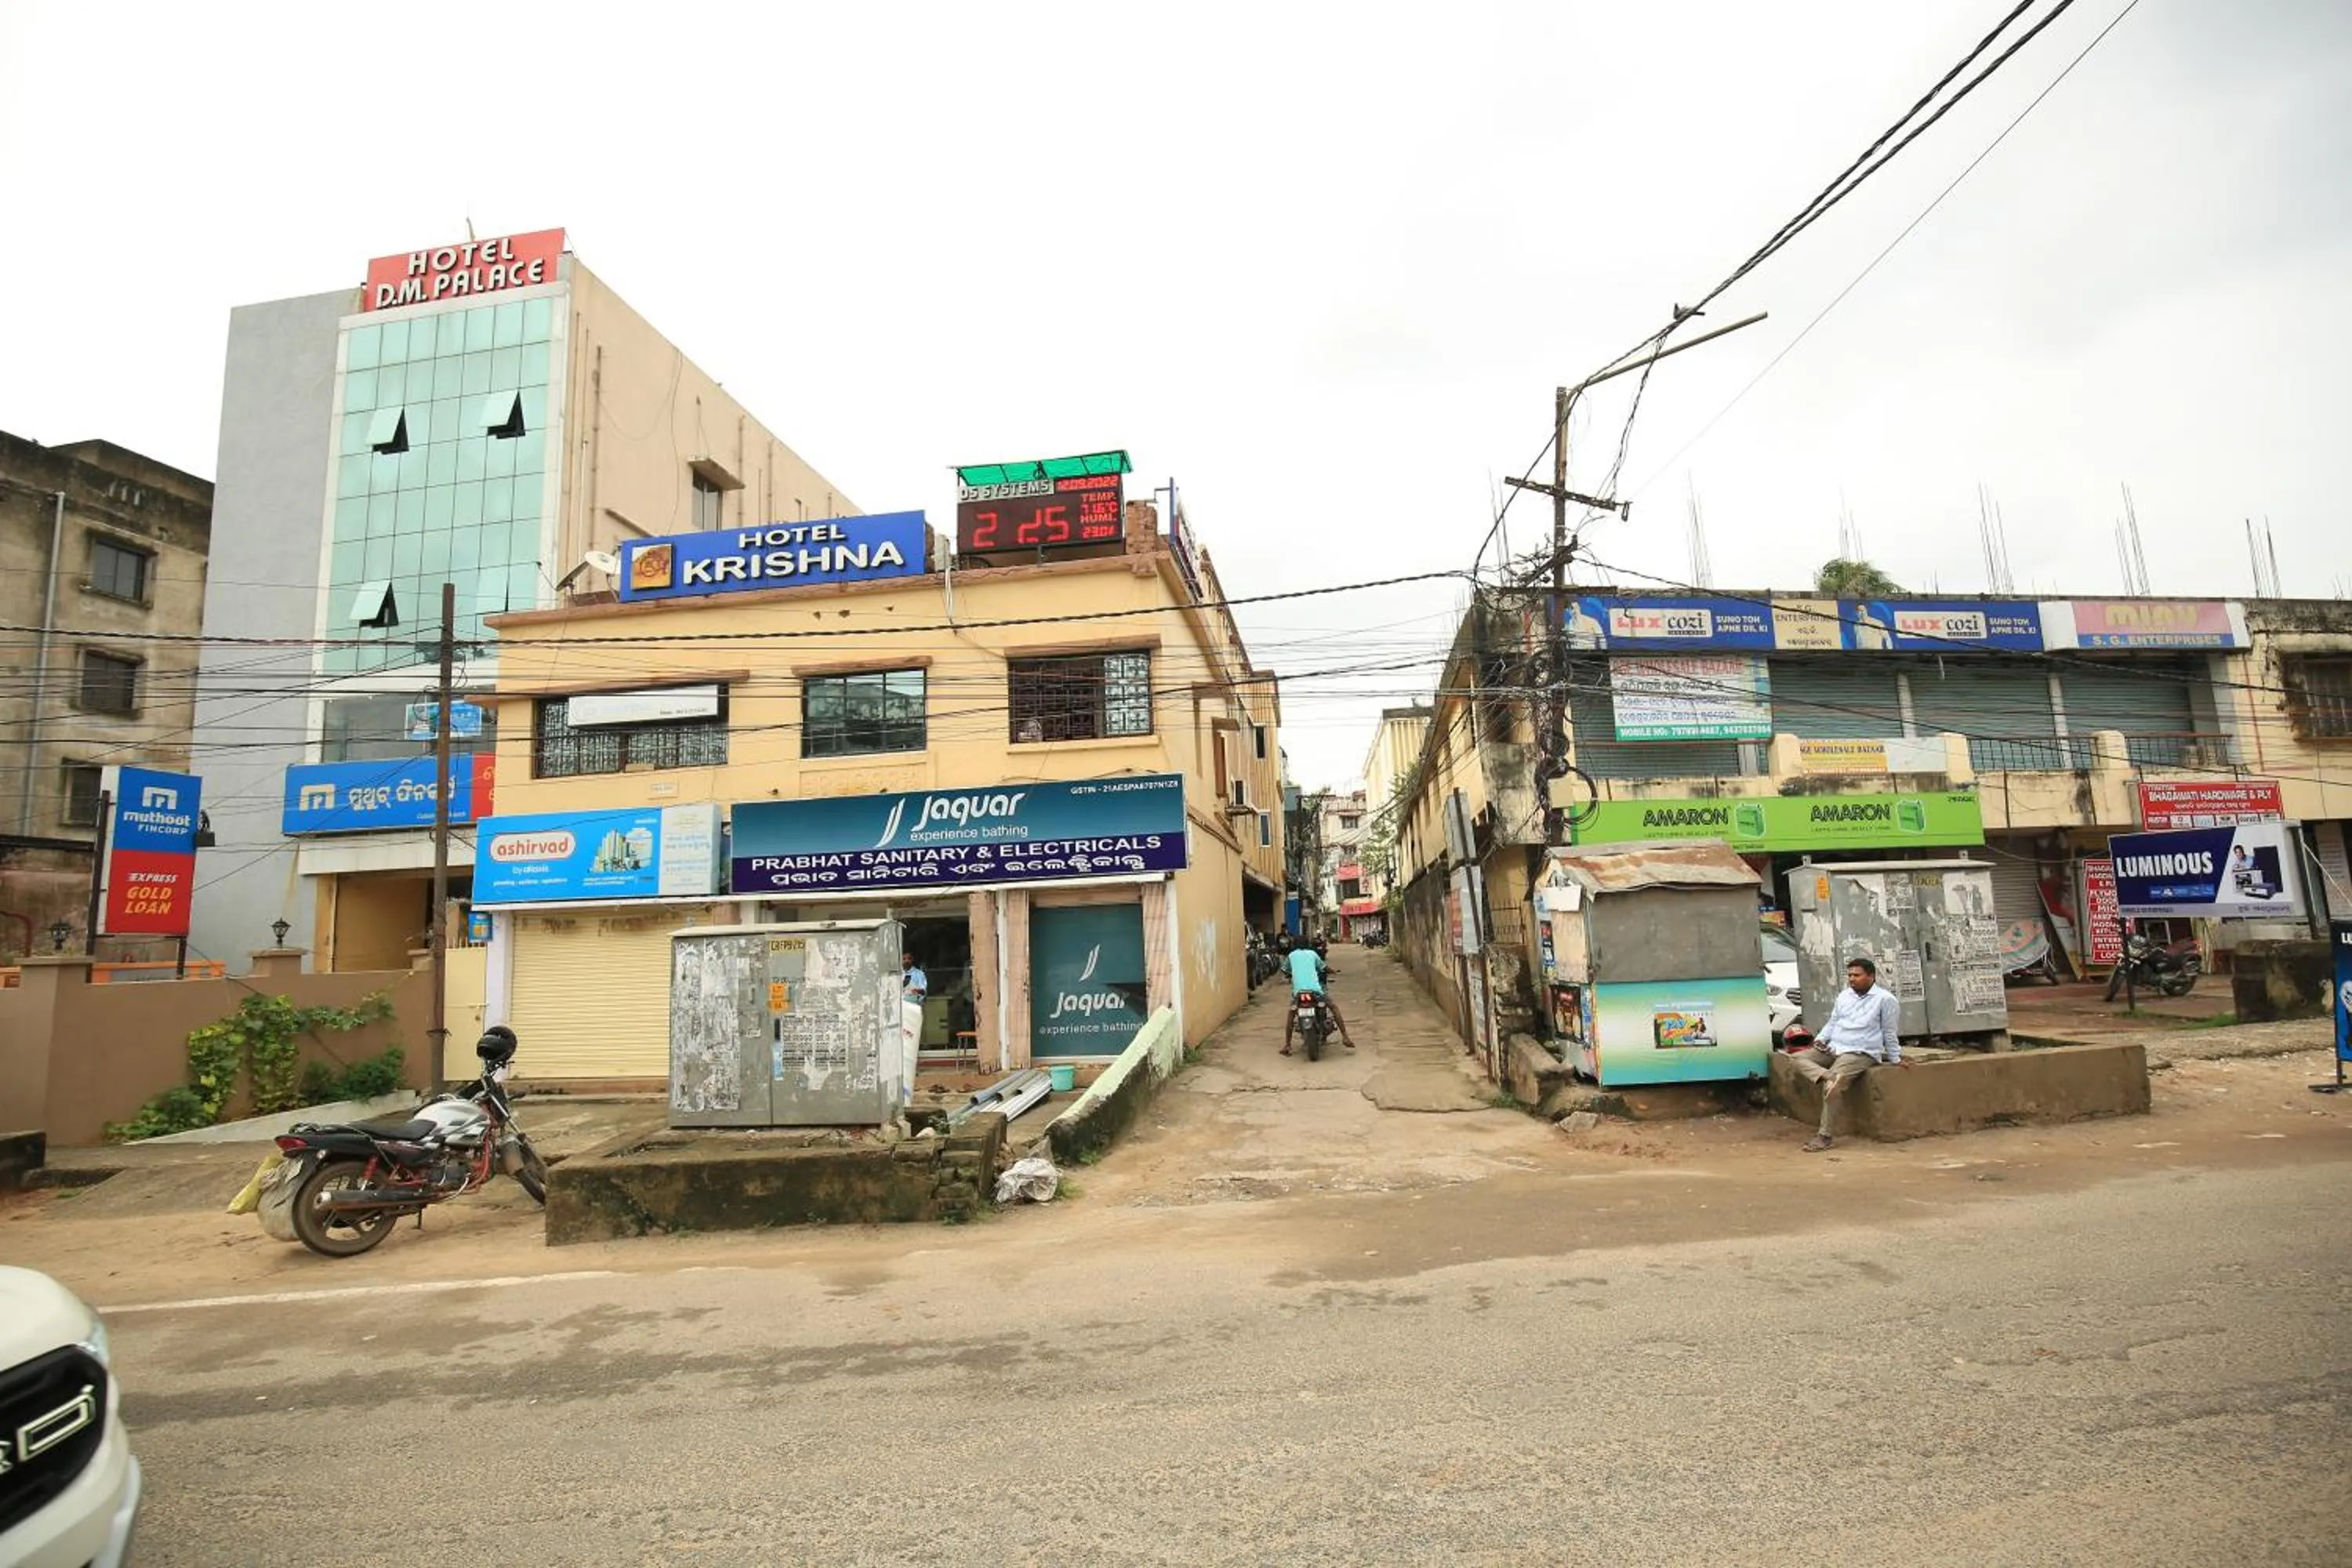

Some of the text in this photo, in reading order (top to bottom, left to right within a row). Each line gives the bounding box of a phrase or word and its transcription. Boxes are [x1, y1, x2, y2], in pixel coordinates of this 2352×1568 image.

[408, 238, 514, 275] HOTEL
[376, 258, 544, 308] D.M. PALACE
[983, 480, 1050, 497] SYSTEMS
[739, 524, 846, 549] HOTEL
[683, 541, 905, 584] KRISHNA
[1668, 612, 1704, 630] cozi
[1901, 615, 1978, 631] LUX cozi
[2129, 635, 2222, 645] ENTERPRISES
[2200, 789, 2248, 801] HARDWARE
[123, 811, 191, 827] muthoot
[911, 793, 1025, 832] Jaquar
[1643, 808, 1729, 827] AMARON
[1811, 804, 1892, 822] AMARON
[138, 823, 188, 836] FINCORP
[910, 825, 1028, 843] experience bathing
[496, 836, 569, 856] ashirvad
[752, 836, 1162, 871] PRABHAT SANITARY & ELECTRICALS
[2118, 851, 2213, 877] LUMINOUS
[127, 872, 180, 884] EXPRESS
[126, 886, 172, 900] GOLD
[125, 901, 172, 915] LOAN
[1039, 1022, 1100, 1035] experience
